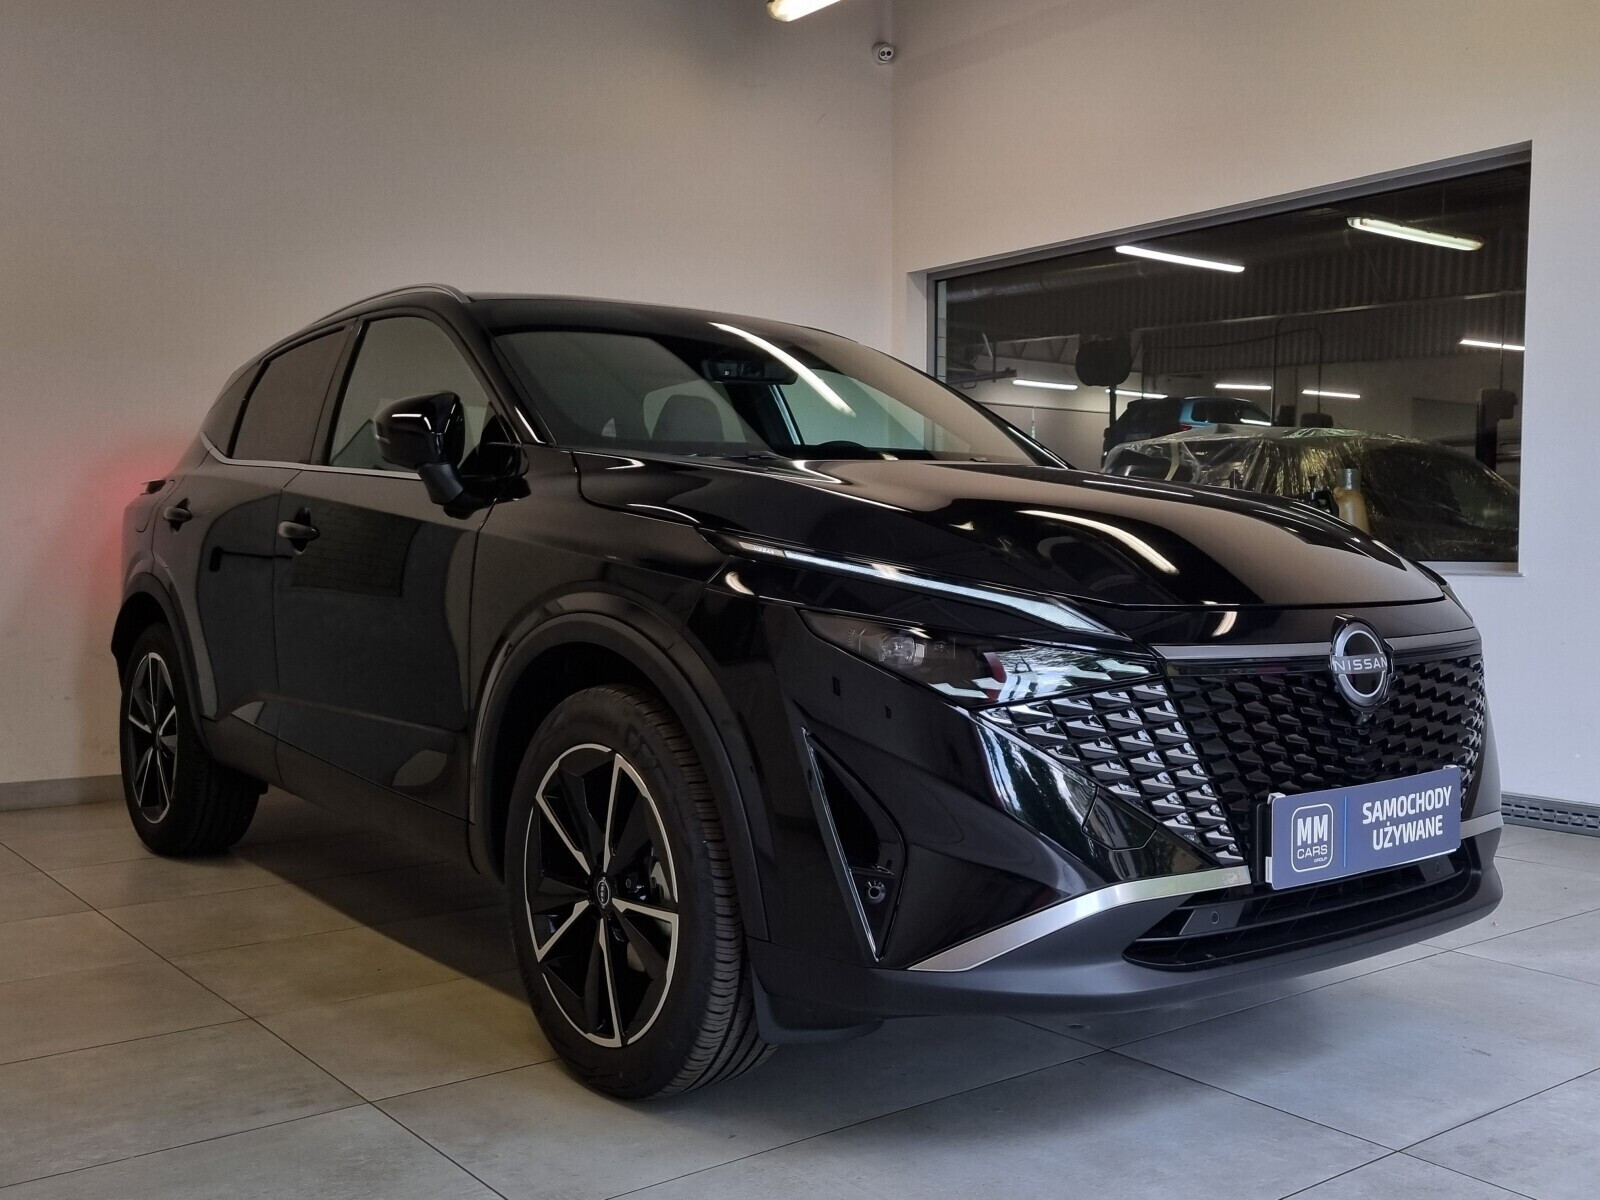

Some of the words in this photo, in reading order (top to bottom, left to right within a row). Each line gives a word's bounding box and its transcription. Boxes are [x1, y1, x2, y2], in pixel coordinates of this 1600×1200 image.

[1333, 657, 1388, 671] NISSAN
[1362, 786, 1452, 824] SAMOCHODY
[1297, 814, 1328, 846] MM
[1373, 815, 1443, 850] UŻYWANE
[1297, 844, 1328, 859] CARS
